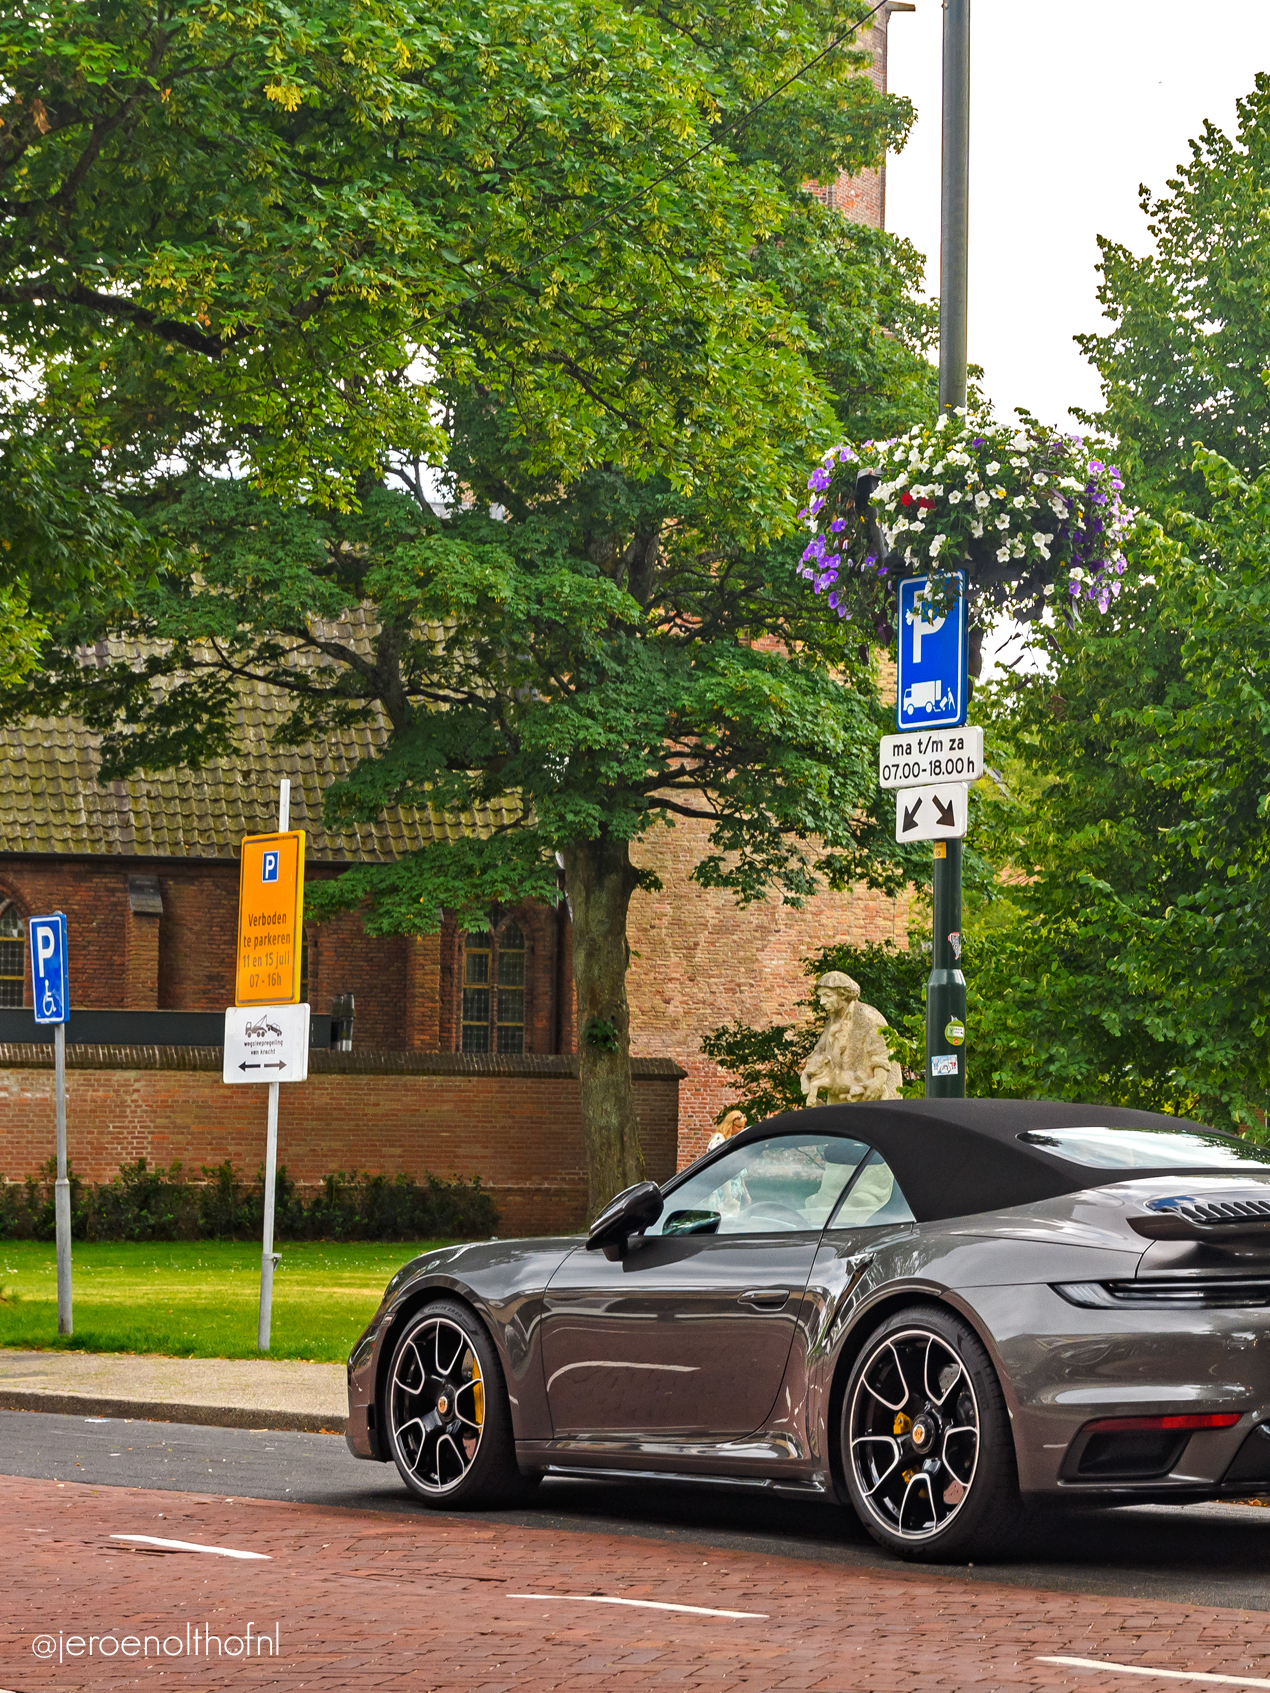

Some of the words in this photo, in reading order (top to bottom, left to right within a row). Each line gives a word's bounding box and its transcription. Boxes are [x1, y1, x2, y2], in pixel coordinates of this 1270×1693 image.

[892, 742, 912, 757] ma
[918, 736, 943, 755] t/m
[949, 736, 965, 751] za
[882, 760, 964, 781] 07.00-18.00
[265, 855, 276, 879] P
[248, 912, 287, 927] Verboden
[244, 938, 252, 948] te
[253, 932, 291, 950] parkeren
[36, 926, 55, 977] P
[242, 954, 250, 968] 11
[252, 957, 262, 967] en
[265, 952, 274, 967] 15
[275, 951, 290, 969] juli
[249, 974, 260, 987] 07
[267, 972, 282, 986] 16h
[244, 1040, 283, 1048] wegsleepregeling
